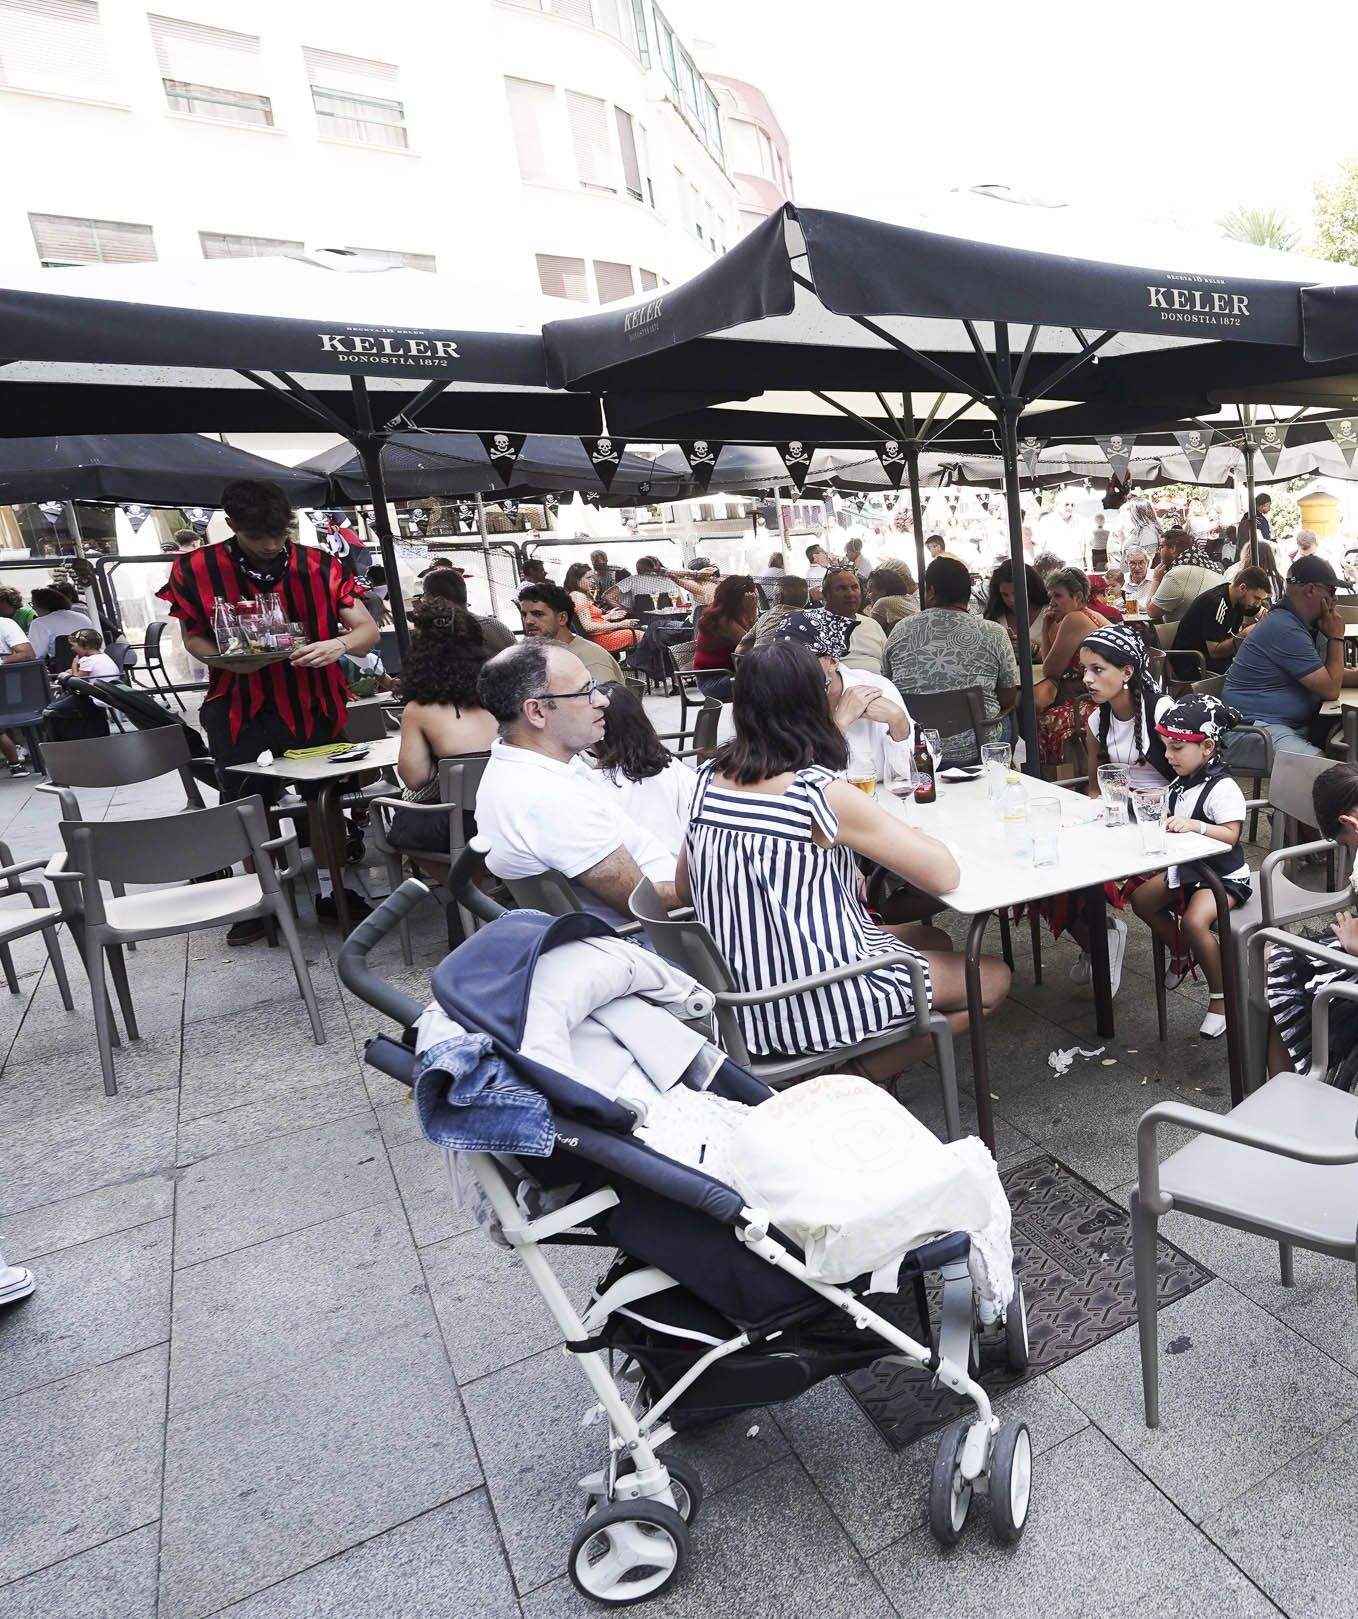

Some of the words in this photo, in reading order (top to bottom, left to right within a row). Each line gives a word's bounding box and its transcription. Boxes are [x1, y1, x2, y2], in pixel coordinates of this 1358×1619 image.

[1147, 286, 1250, 316] KELER
[624, 298, 664, 332] KELER
[1161, 312, 1217, 324] DONOSTIA
[1220, 317, 1241, 326] 1872
[318, 334, 461, 358] KELER
[338, 354, 415, 365] DONOSTIA
[419, 359, 448, 367] 1872
[1029, 1212, 1051, 1231] 700
[1054, 1231, 1101, 1266] AKSESS
